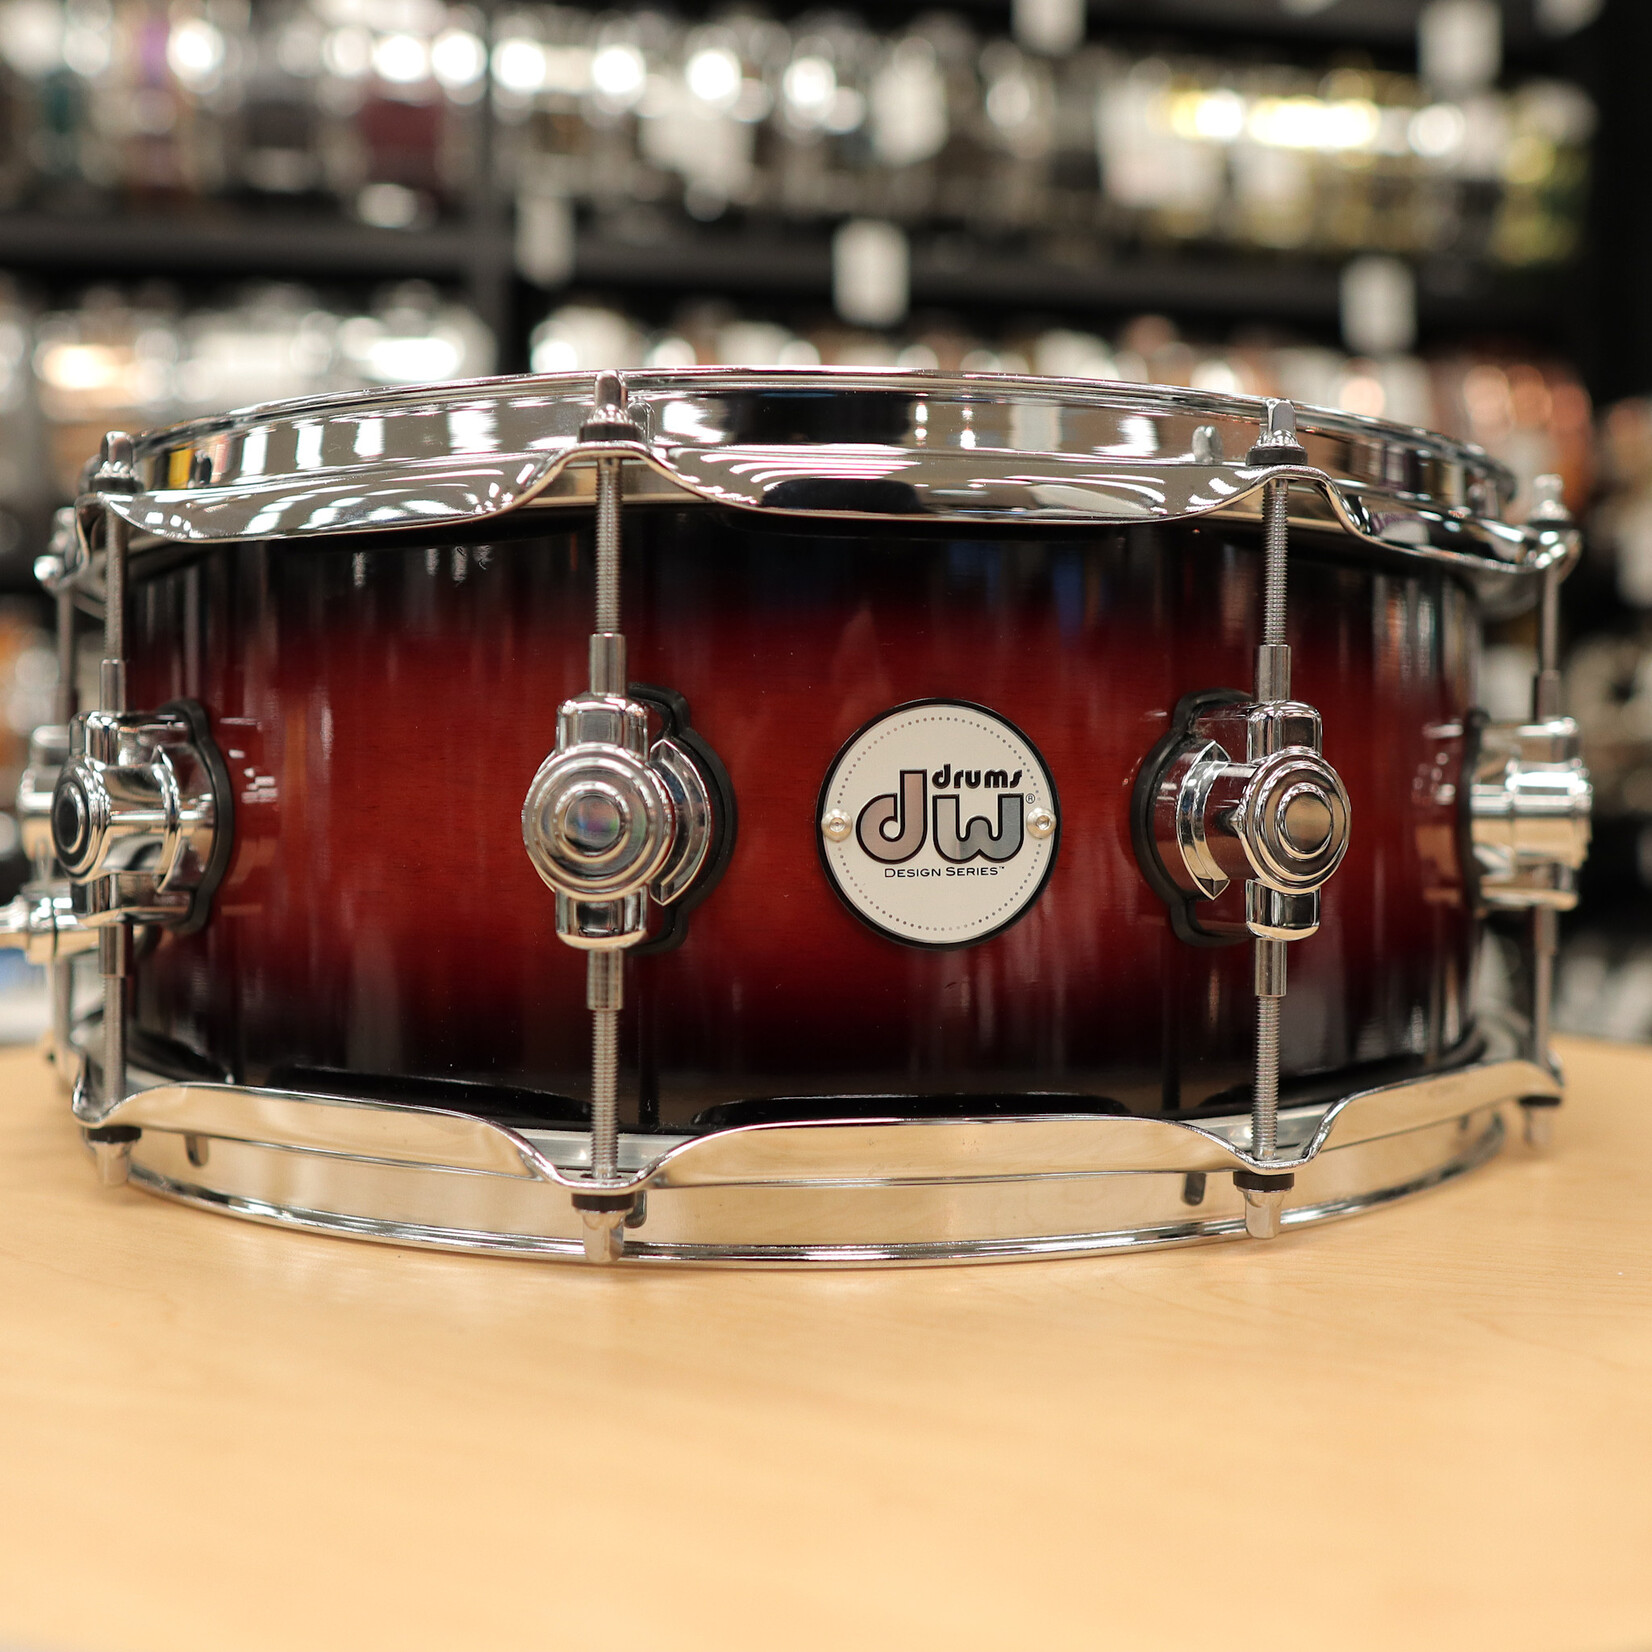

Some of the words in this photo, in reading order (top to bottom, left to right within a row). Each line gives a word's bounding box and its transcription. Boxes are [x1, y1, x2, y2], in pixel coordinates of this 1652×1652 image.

[931, 764, 1023, 789] drums
[855, 769, 1025, 864] dw
[884, 867, 941, 878] DESIGN
